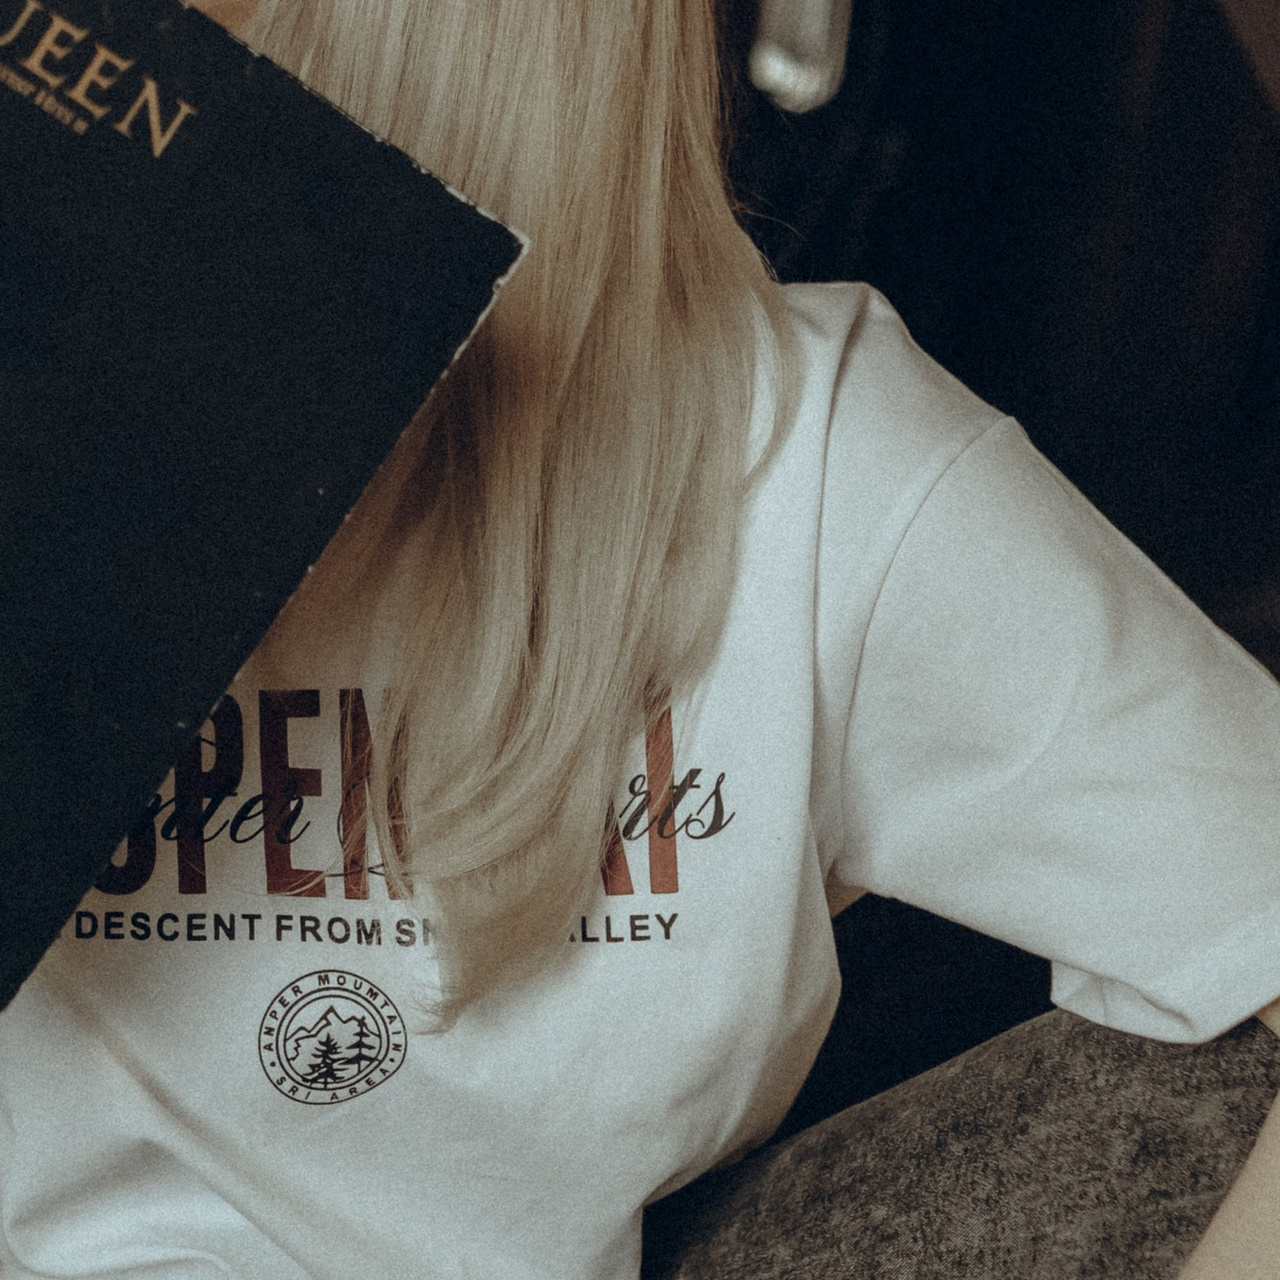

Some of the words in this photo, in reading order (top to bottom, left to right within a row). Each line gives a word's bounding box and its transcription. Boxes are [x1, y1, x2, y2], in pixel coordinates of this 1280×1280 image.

[92, 687, 414, 900] PEN
[618, 768, 736, 842] rts
[74, 910, 262, 943] DESCENT
[275, 912, 382, 946] FROM
[569, 912, 680, 943] LLEY
[329, 1067, 391, 1102] AREA
